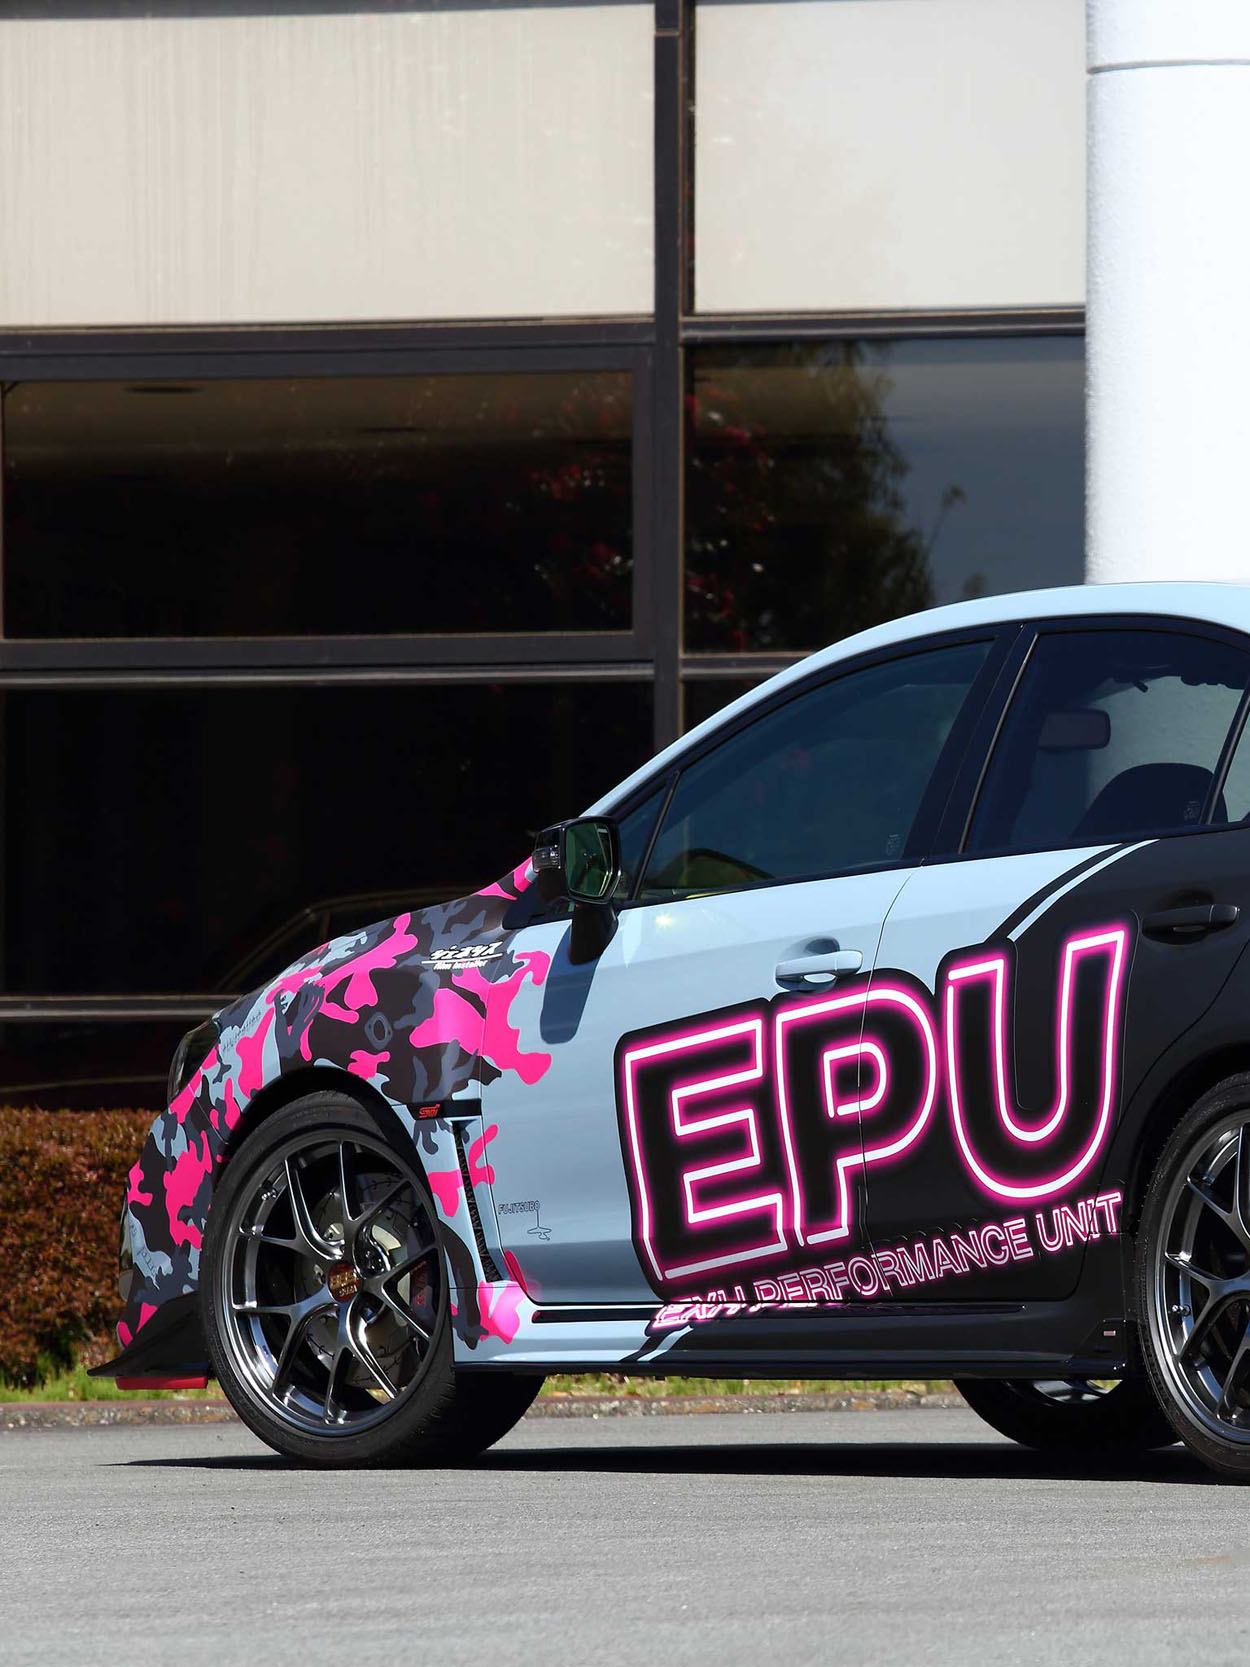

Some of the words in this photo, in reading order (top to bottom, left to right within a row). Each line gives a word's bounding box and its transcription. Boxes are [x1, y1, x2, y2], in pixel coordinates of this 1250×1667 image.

[622, 925, 1130, 1283] EPU
[749, 1217, 1034, 1313] PERFORMANCE
[1035, 1191, 1122, 1253] UNIT
